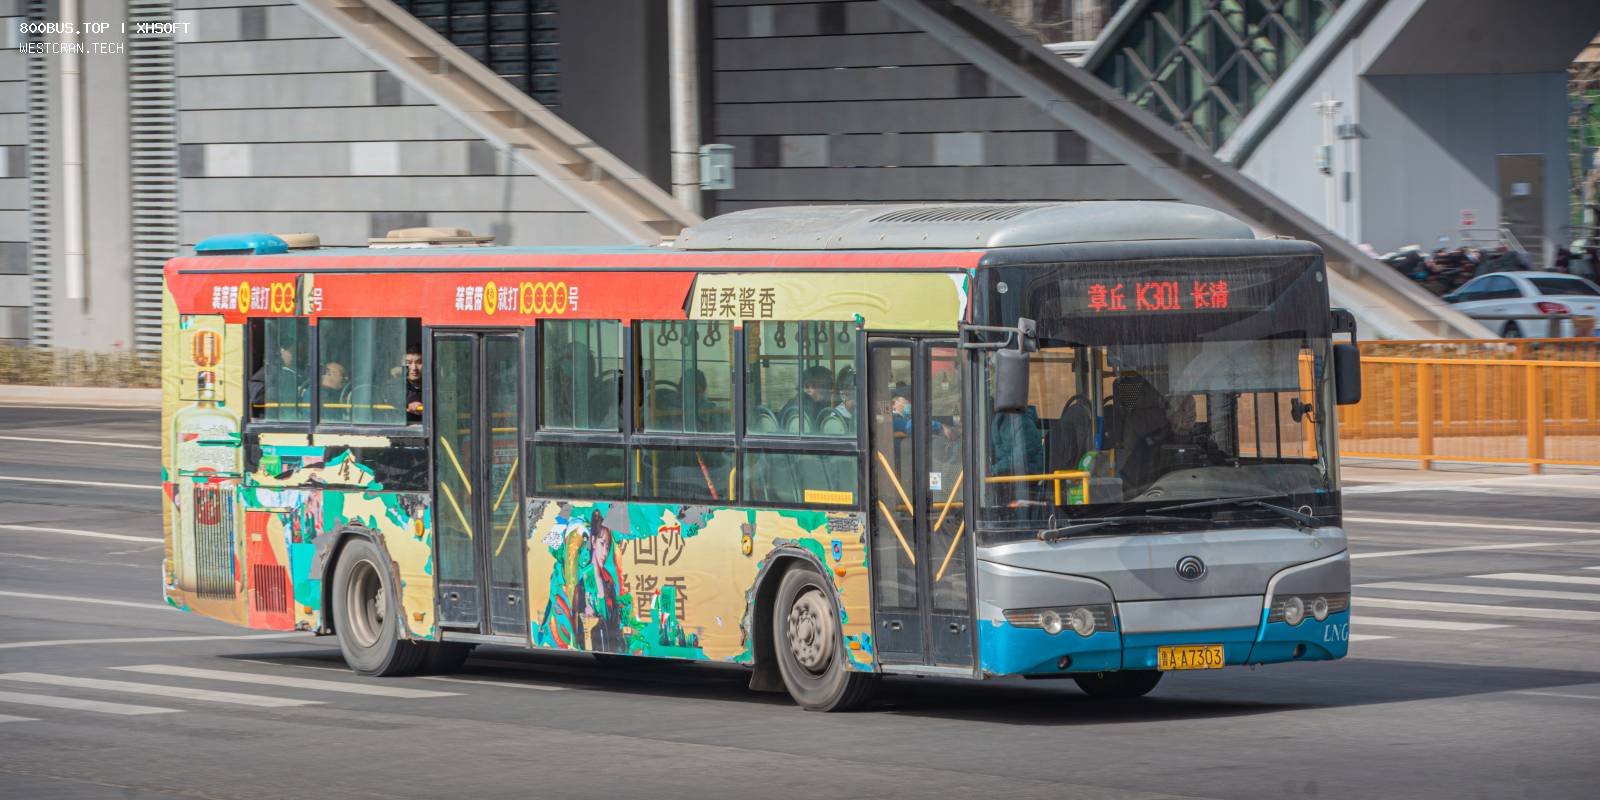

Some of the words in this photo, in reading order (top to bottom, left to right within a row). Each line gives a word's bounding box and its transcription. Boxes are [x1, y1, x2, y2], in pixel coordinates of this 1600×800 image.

[700, 286, 776, 318] 醇柔酱香
[1087, 283, 1128, 312] 章丘
[1136, 280, 1182, 311] K301
[1191, 279, 1230, 309] 长清
[621, 529, 686, 566] 回沙
[1323, 623, 1348, 642] LNG
